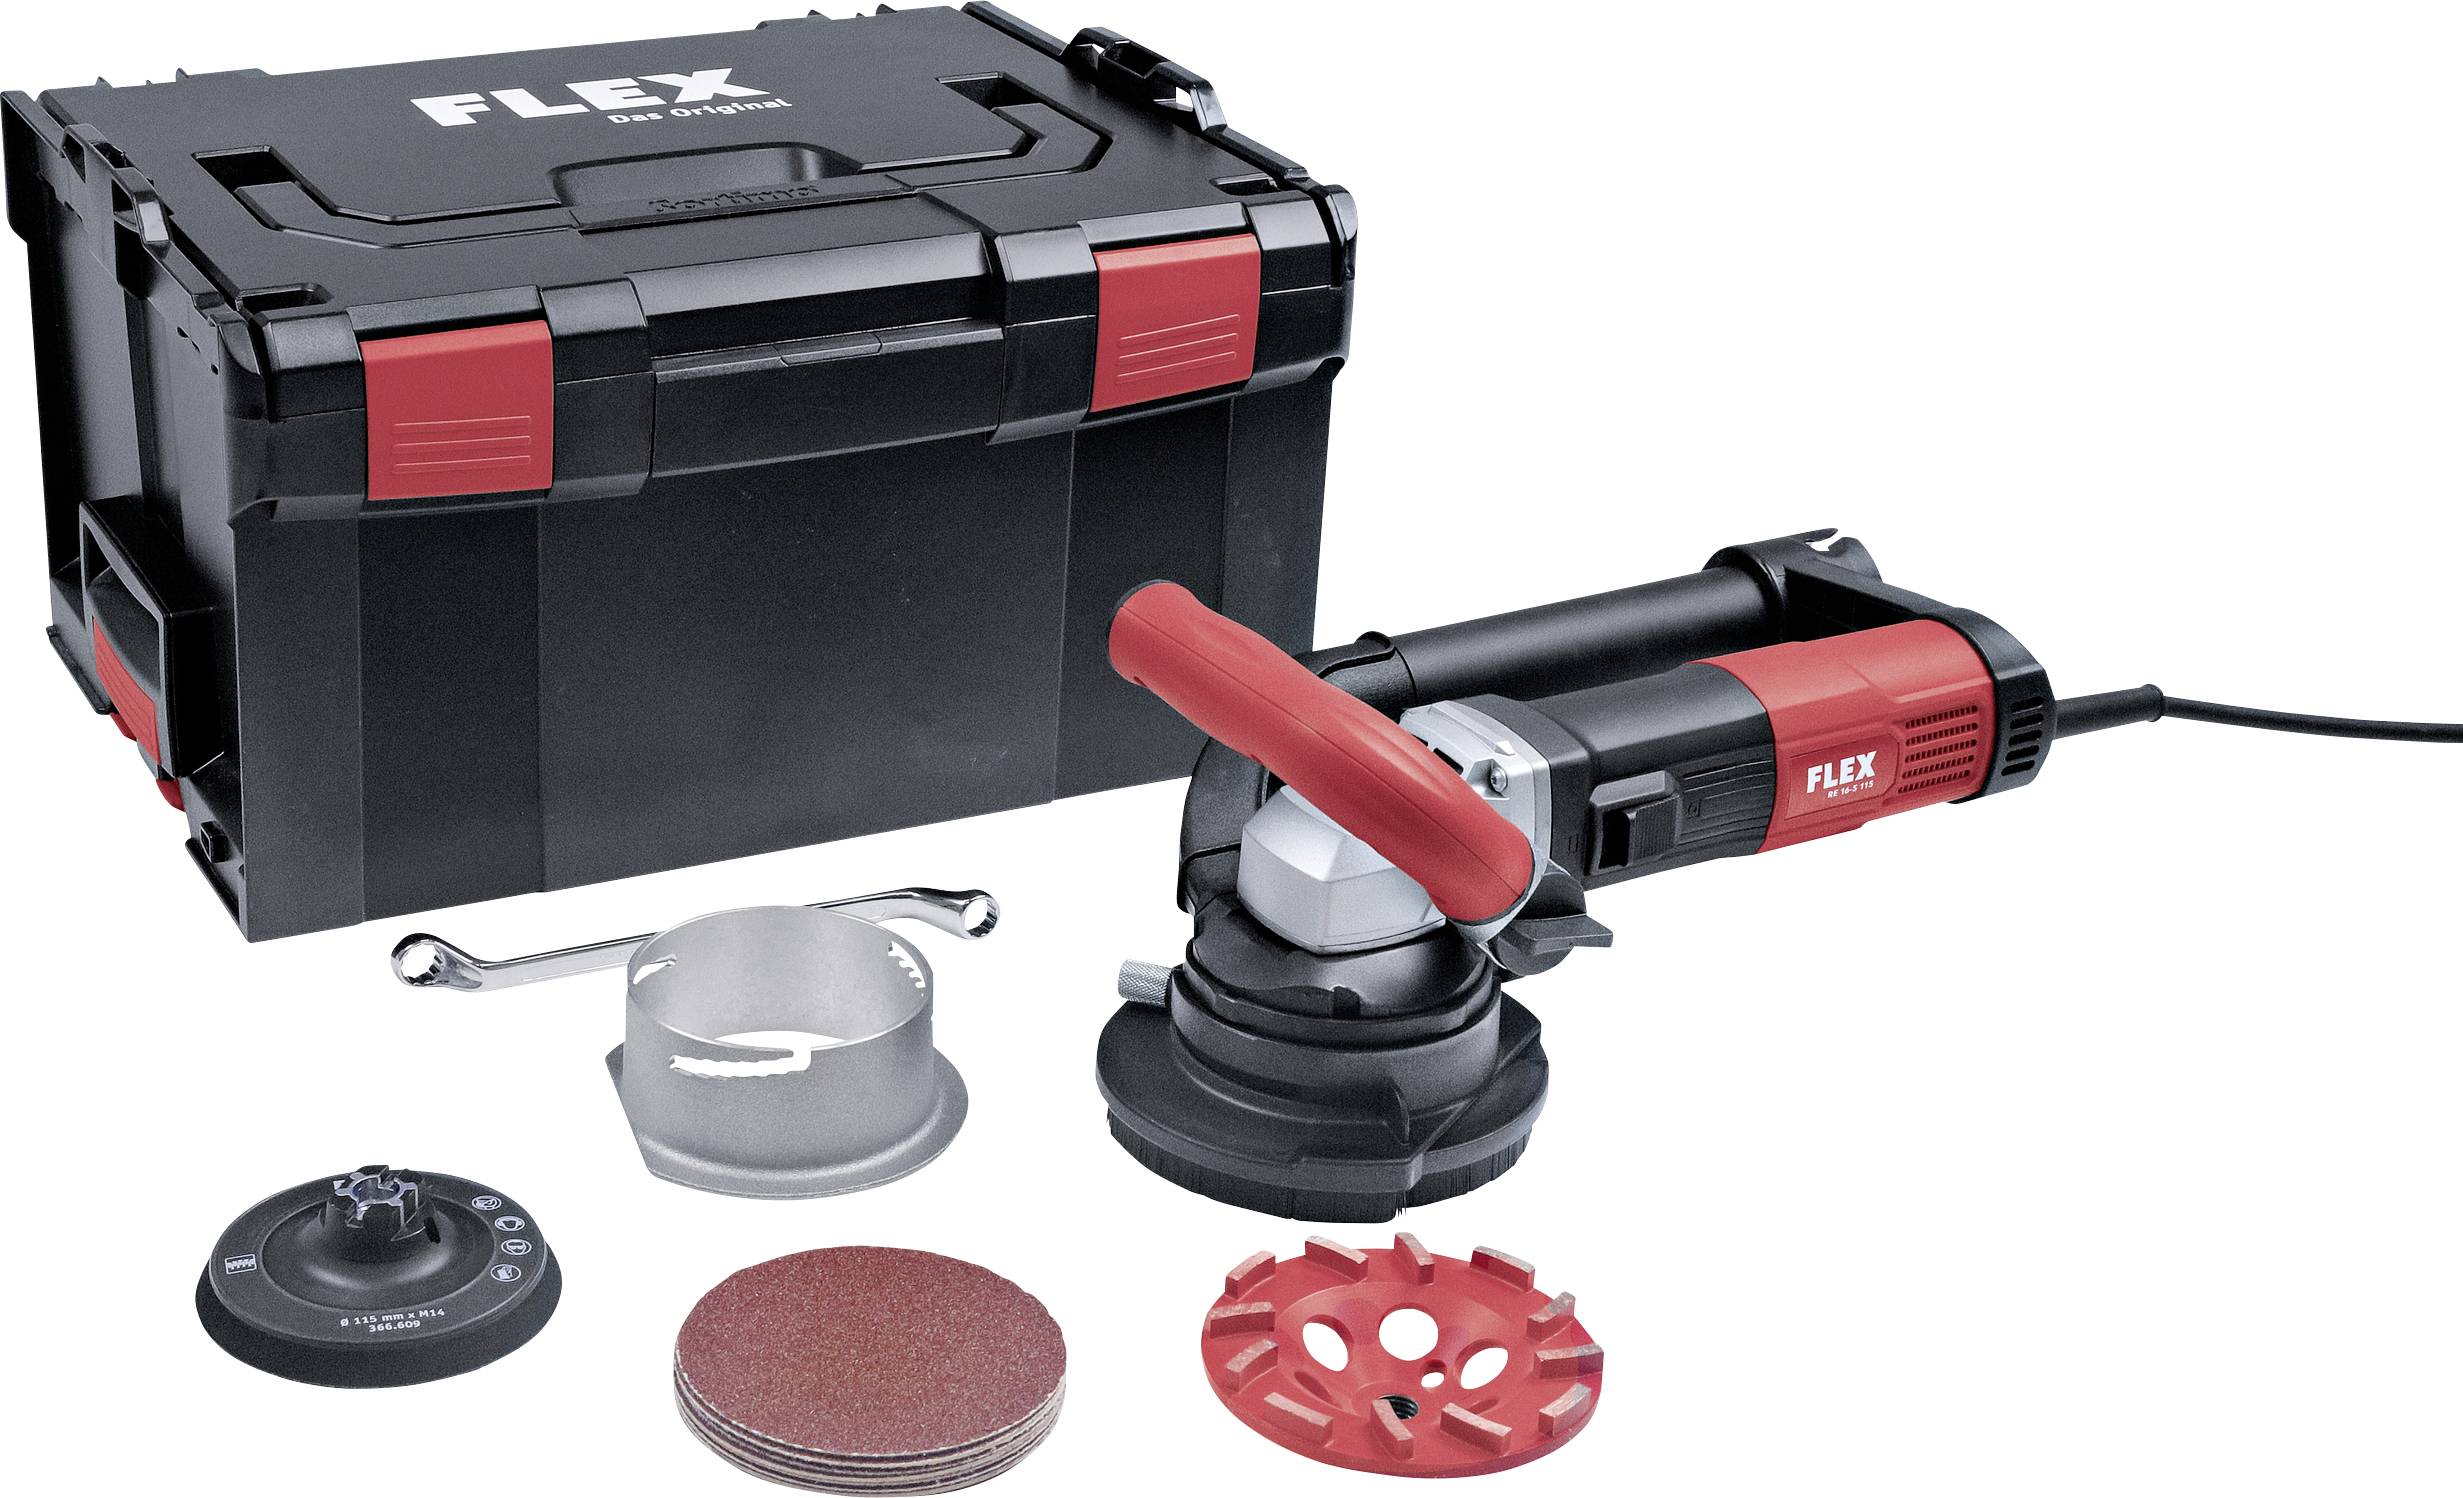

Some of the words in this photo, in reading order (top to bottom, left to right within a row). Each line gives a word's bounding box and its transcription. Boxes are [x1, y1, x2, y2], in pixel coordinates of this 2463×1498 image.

[410, 67, 771, 127] FLEX
[607, 111, 664, 124] Das
[669, 98, 793, 118] Original
[1806, 750, 1877, 794] FLEX
[1827, 789, 1838, 798] RE
[1860, 780, 1873, 790] 115
[354, 1315, 378, 1325] 115
[382, 1313, 404, 1322] mm
[408, 1311, 416, 1319] x
[418, 1308, 445, 1318] M14
[368, 1320, 421, 1332] 366.609
